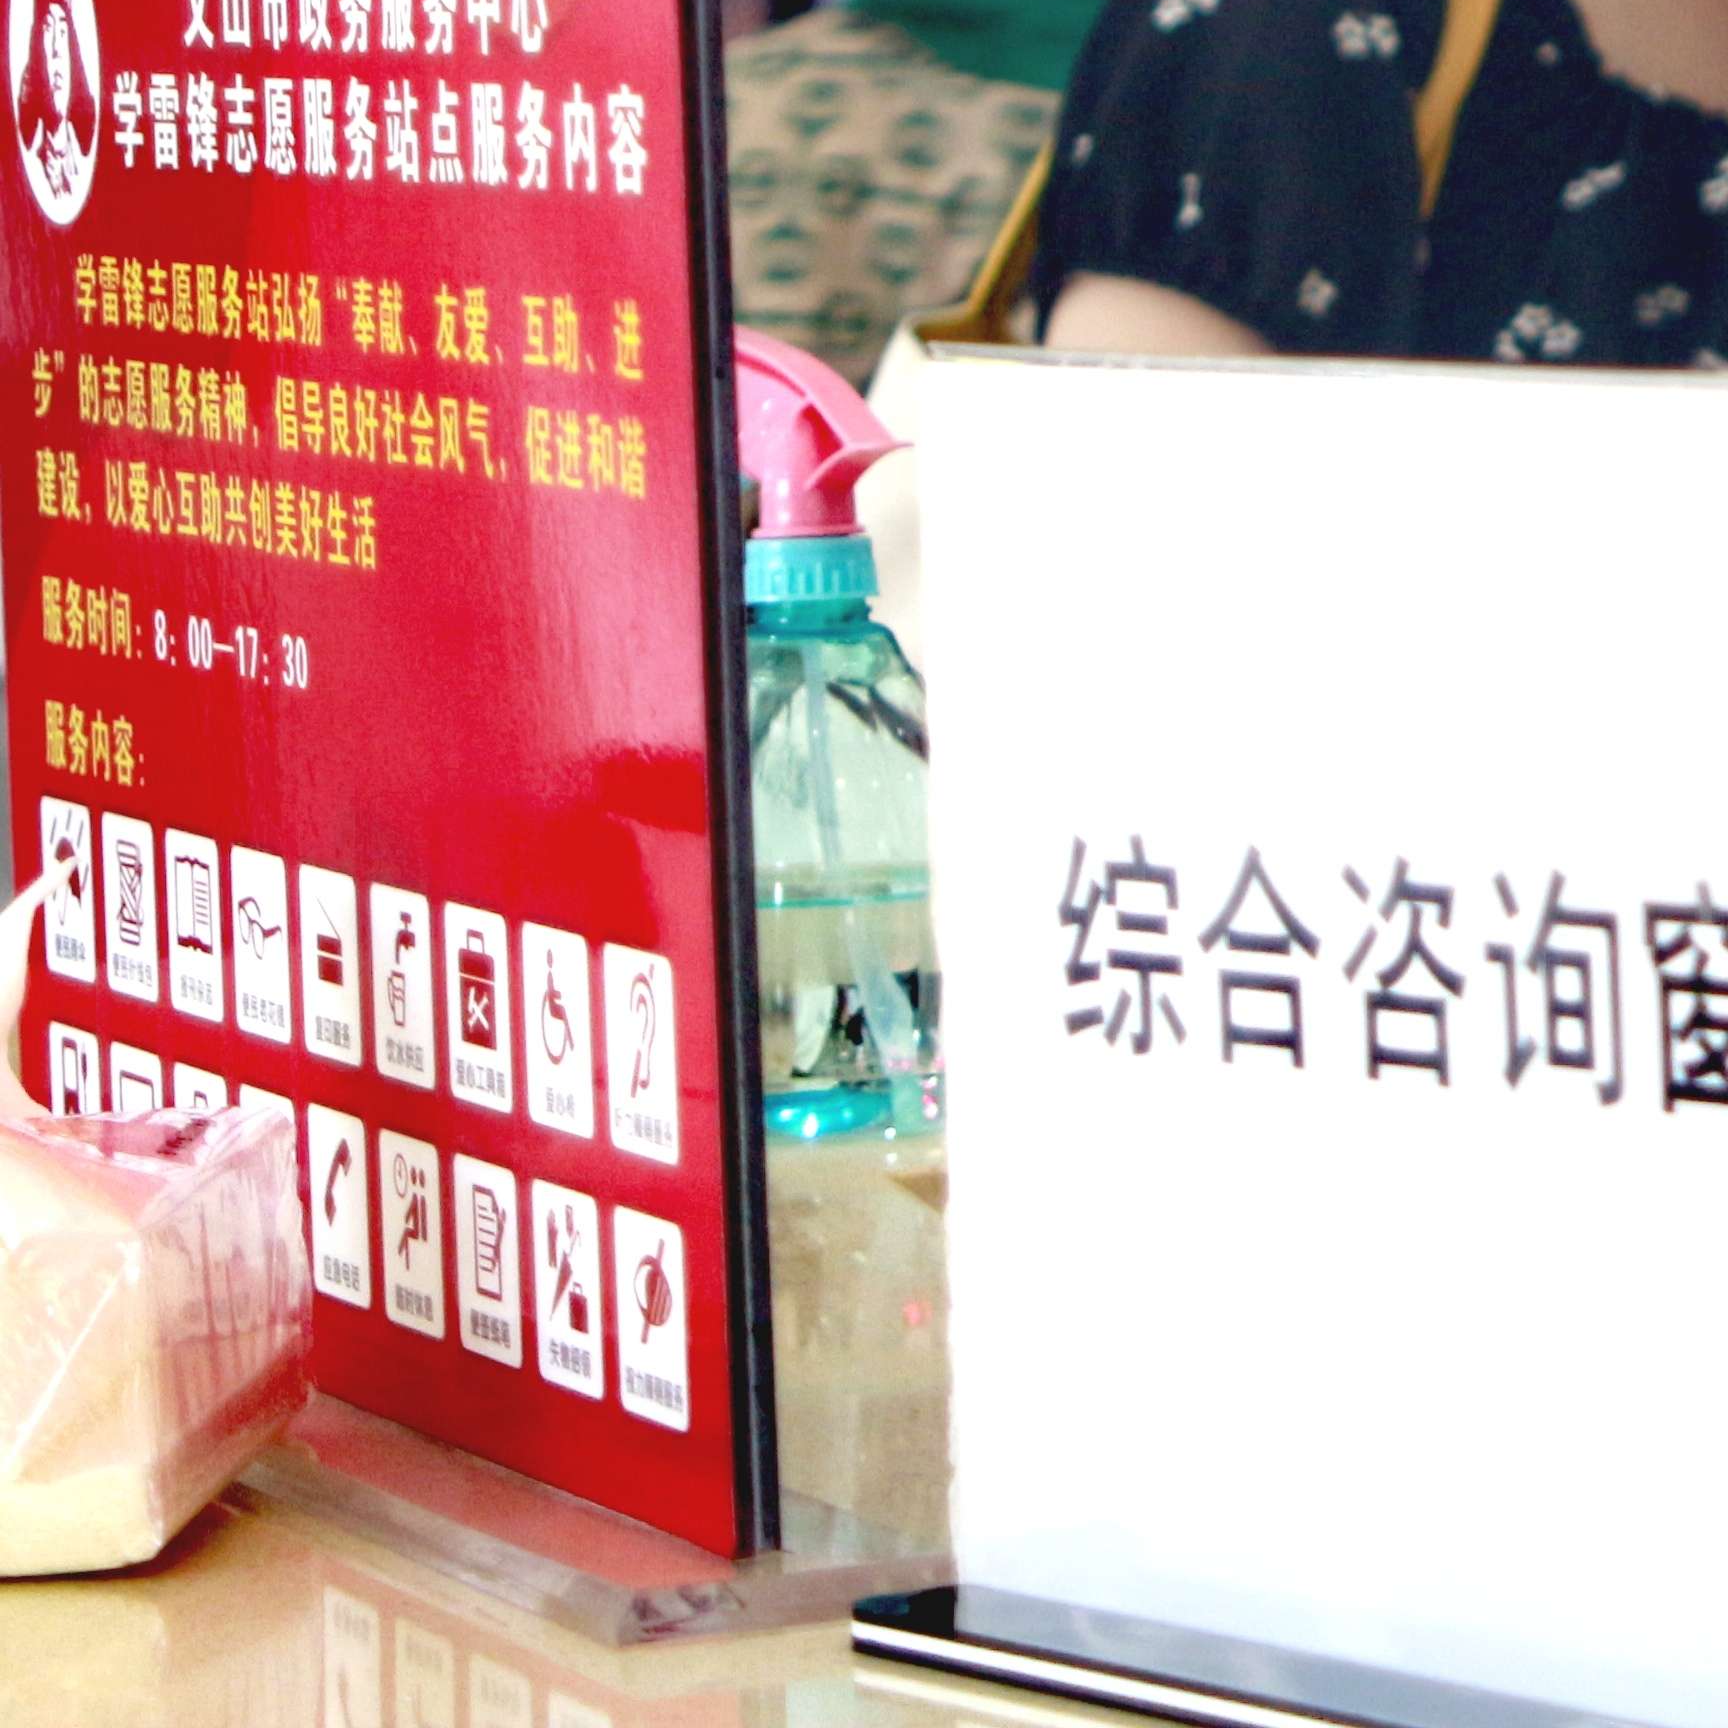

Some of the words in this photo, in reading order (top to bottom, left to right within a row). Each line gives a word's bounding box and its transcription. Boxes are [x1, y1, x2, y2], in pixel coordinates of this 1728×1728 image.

[113, 71, 648, 196] 学雷锋志愿服务站点服务内容
